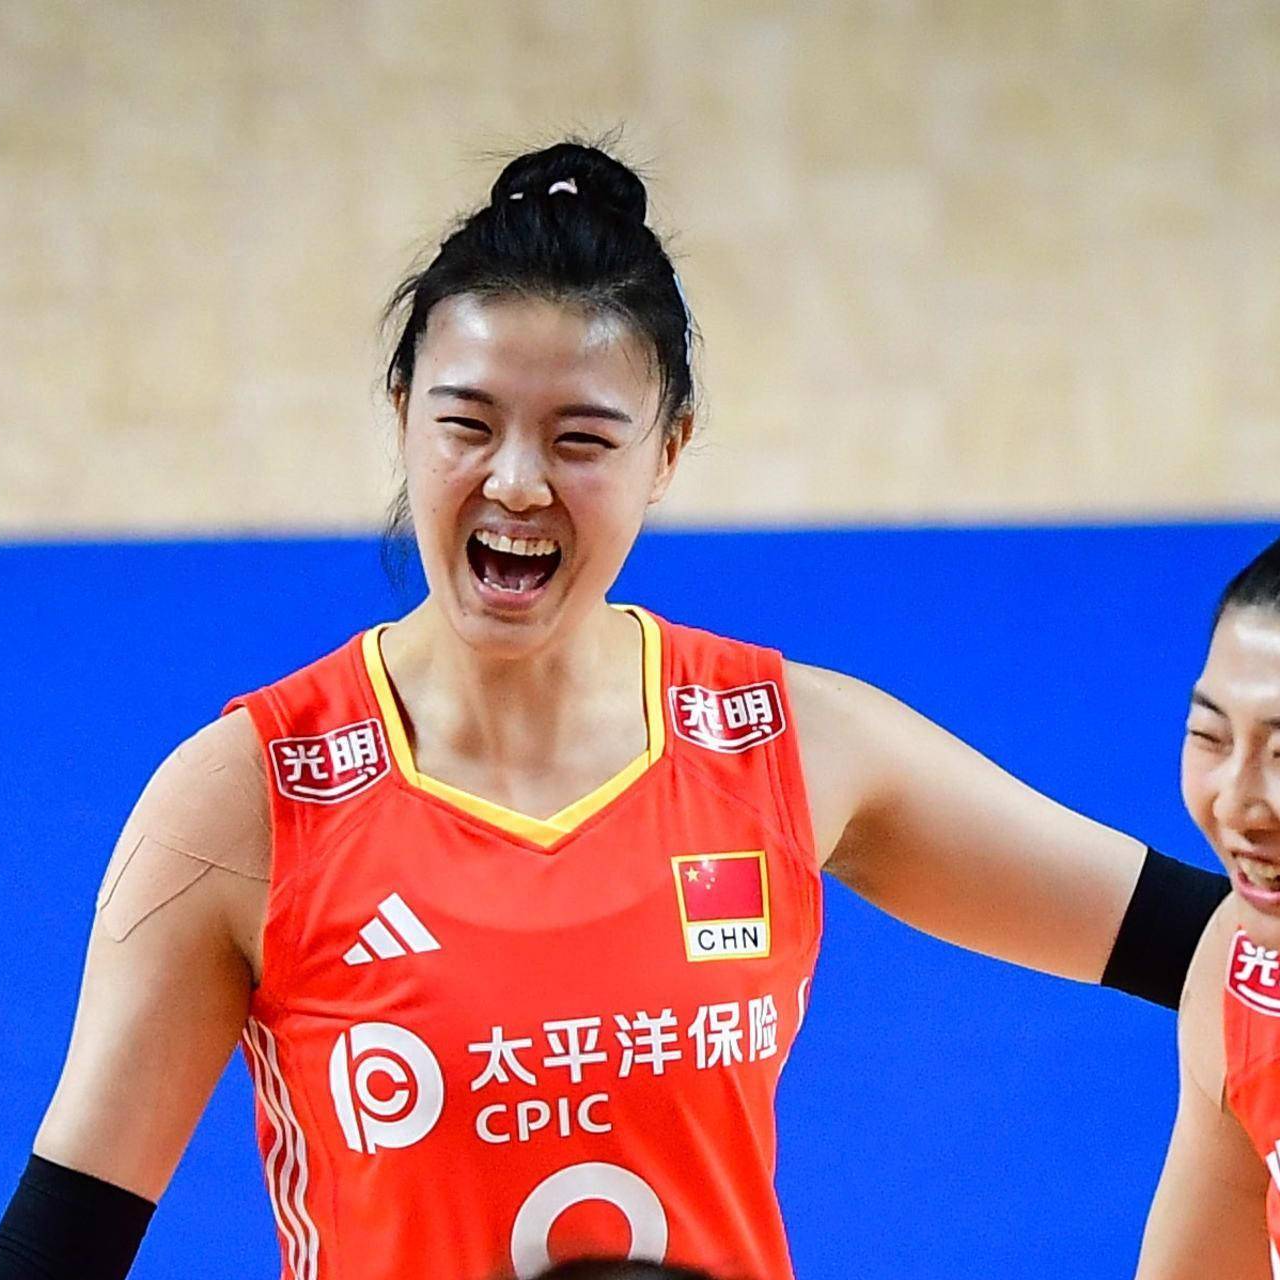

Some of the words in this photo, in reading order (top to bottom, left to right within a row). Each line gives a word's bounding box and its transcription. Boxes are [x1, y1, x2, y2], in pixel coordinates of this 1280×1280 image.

[678, 688, 775, 731] 光明
[280, 727, 379, 782] 光明
[697, 926, 759, 951] CHN
[467, 994, 778, 1092] 太平洋保险
[475, 1093, 613, 1144] CPIC
